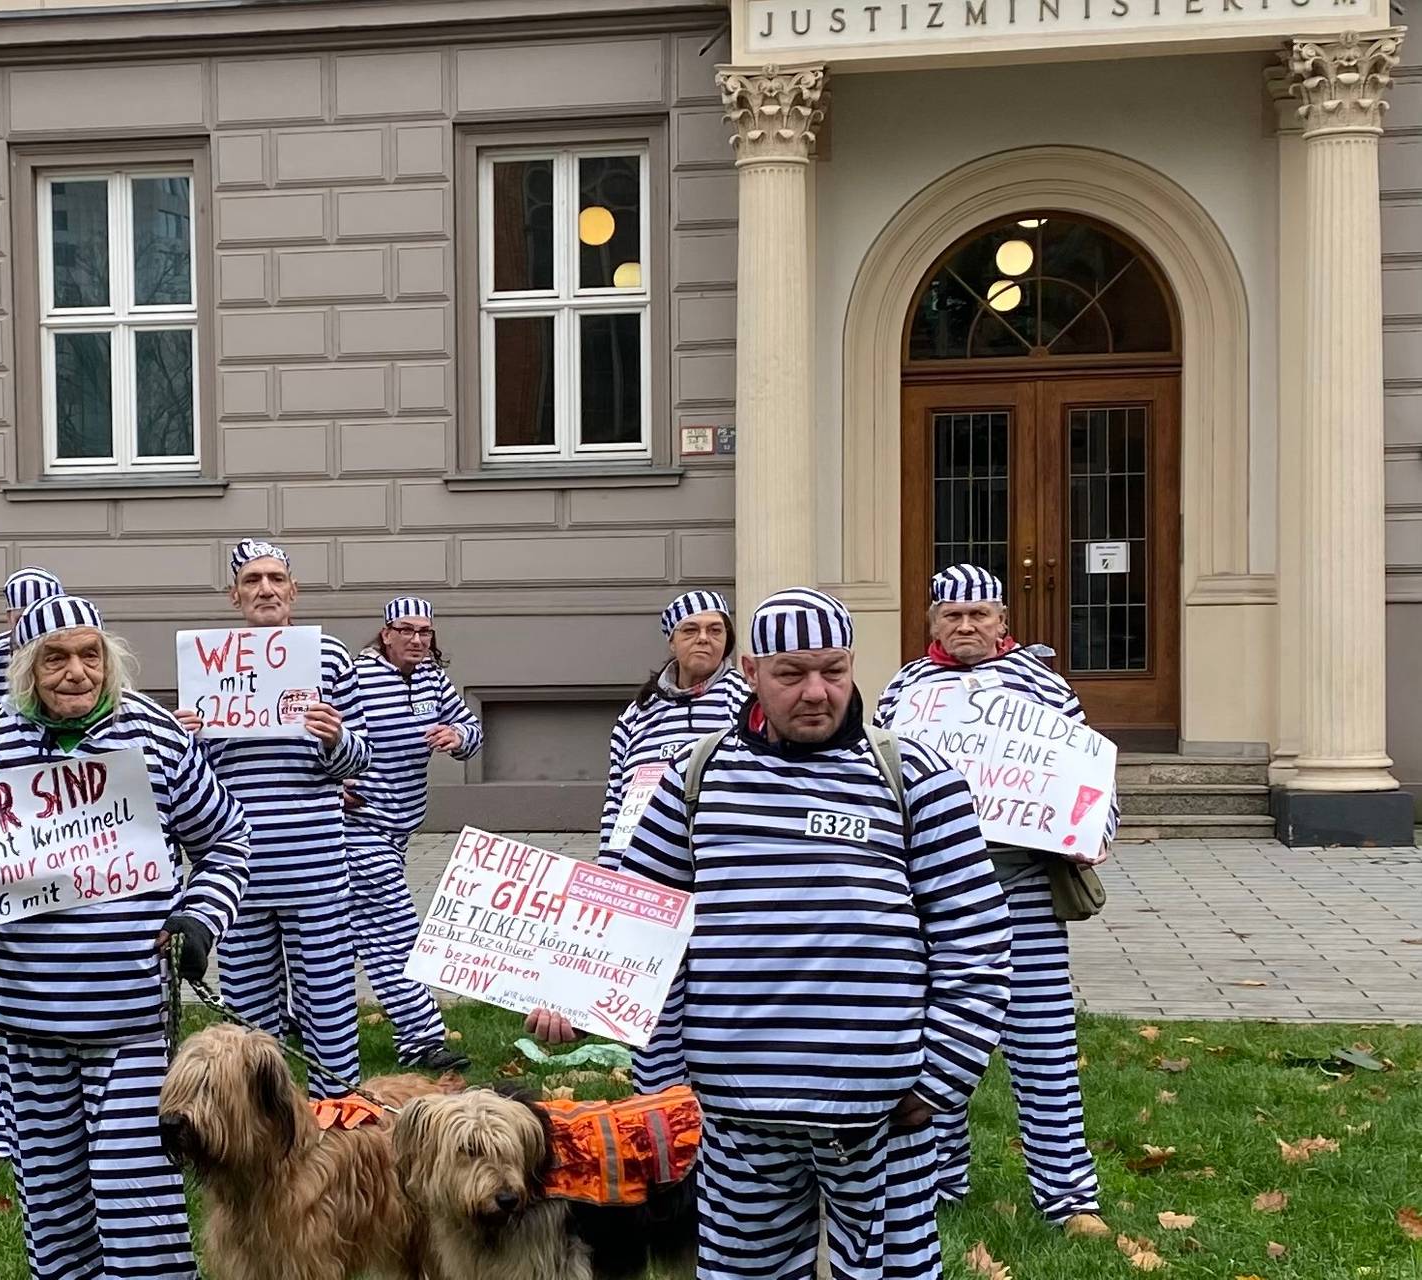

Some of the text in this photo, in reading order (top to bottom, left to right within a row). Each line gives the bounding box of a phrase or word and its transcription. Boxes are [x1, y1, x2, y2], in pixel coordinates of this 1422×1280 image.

[760, 0, 1356, 37] JUSTIZMINISTE
[195, 630, 288, 676] WEG
[220, 671, 258, 693] mit
[195, 695, 271, 729] §265a
[901, 686, 1103, 757] SIE SCHULDEN
[936, 730, 988, 755] NOCH
[1002, 739, 1059, 768] EINE
[31, 761, 108, 819] SIND
[955, 758, 1059, 794] TWORT
[810, 813, 866, 839] 6328
[972, 794, 1057, 834] NISTER
[0, 857, 37, 885] nur
[455, 831, 560, 888] FREIHEIT
[22, 883, 61, 909] mit
[74, 851, 161, 899] §265a
[577, 871, 661, 903] TASCHE LEER
[491, 881, 568, 925] GISA
[569, 884, 637, 916] SCHNAUZE
[423, 922, 466, 941] mehr
[432, 895, 465, 921] DIE
[467, 905, 538, 944] TICKETS
[621, 955, 665, 976] nicht
[440, 960, 499, 994] ÖPNV
[444, 943, 541, 981] bezahlbaren
[549, 953, 639, 988] SOZIALTICKET
